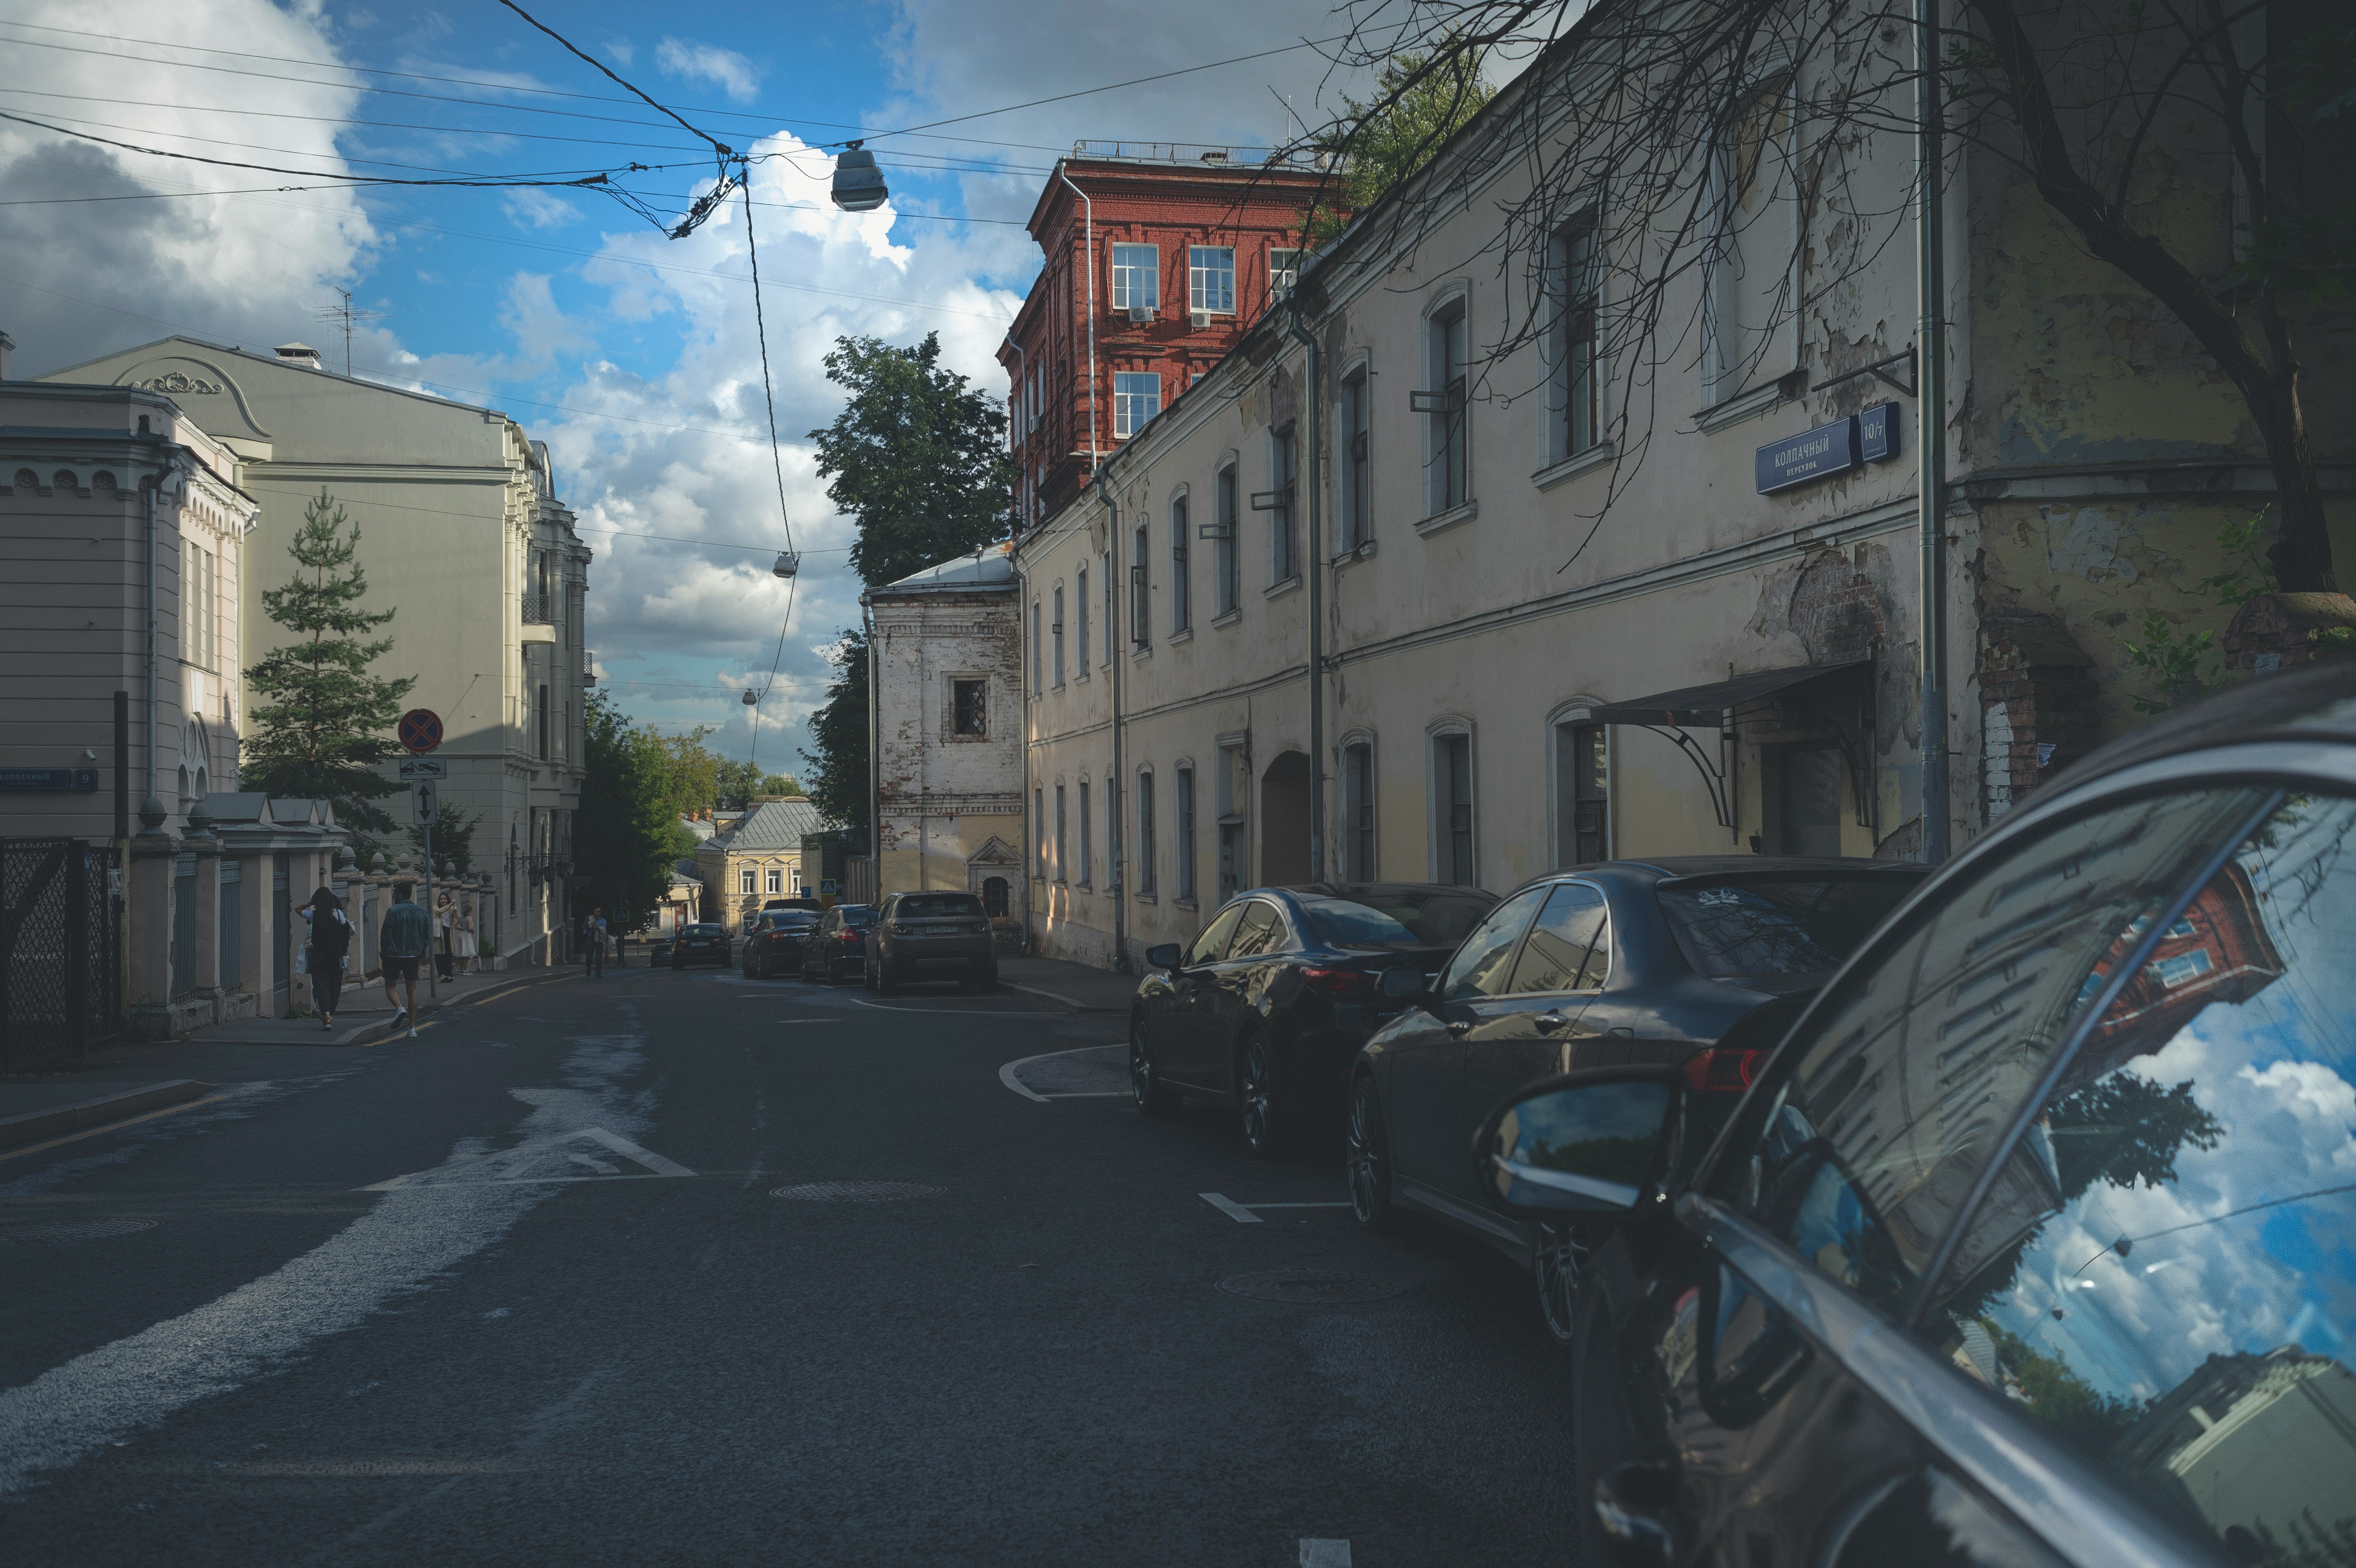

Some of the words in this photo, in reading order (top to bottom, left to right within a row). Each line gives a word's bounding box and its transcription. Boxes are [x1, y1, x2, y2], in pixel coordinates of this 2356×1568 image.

[1864, 420, 1883, 440] 10/7
[1775, 434, 1829, 468] КОЛПАЧНЫЙ
[1787, 460, 1817, 477] ПЕРЕУЛОК
[82, 773, 89, 784] 9
